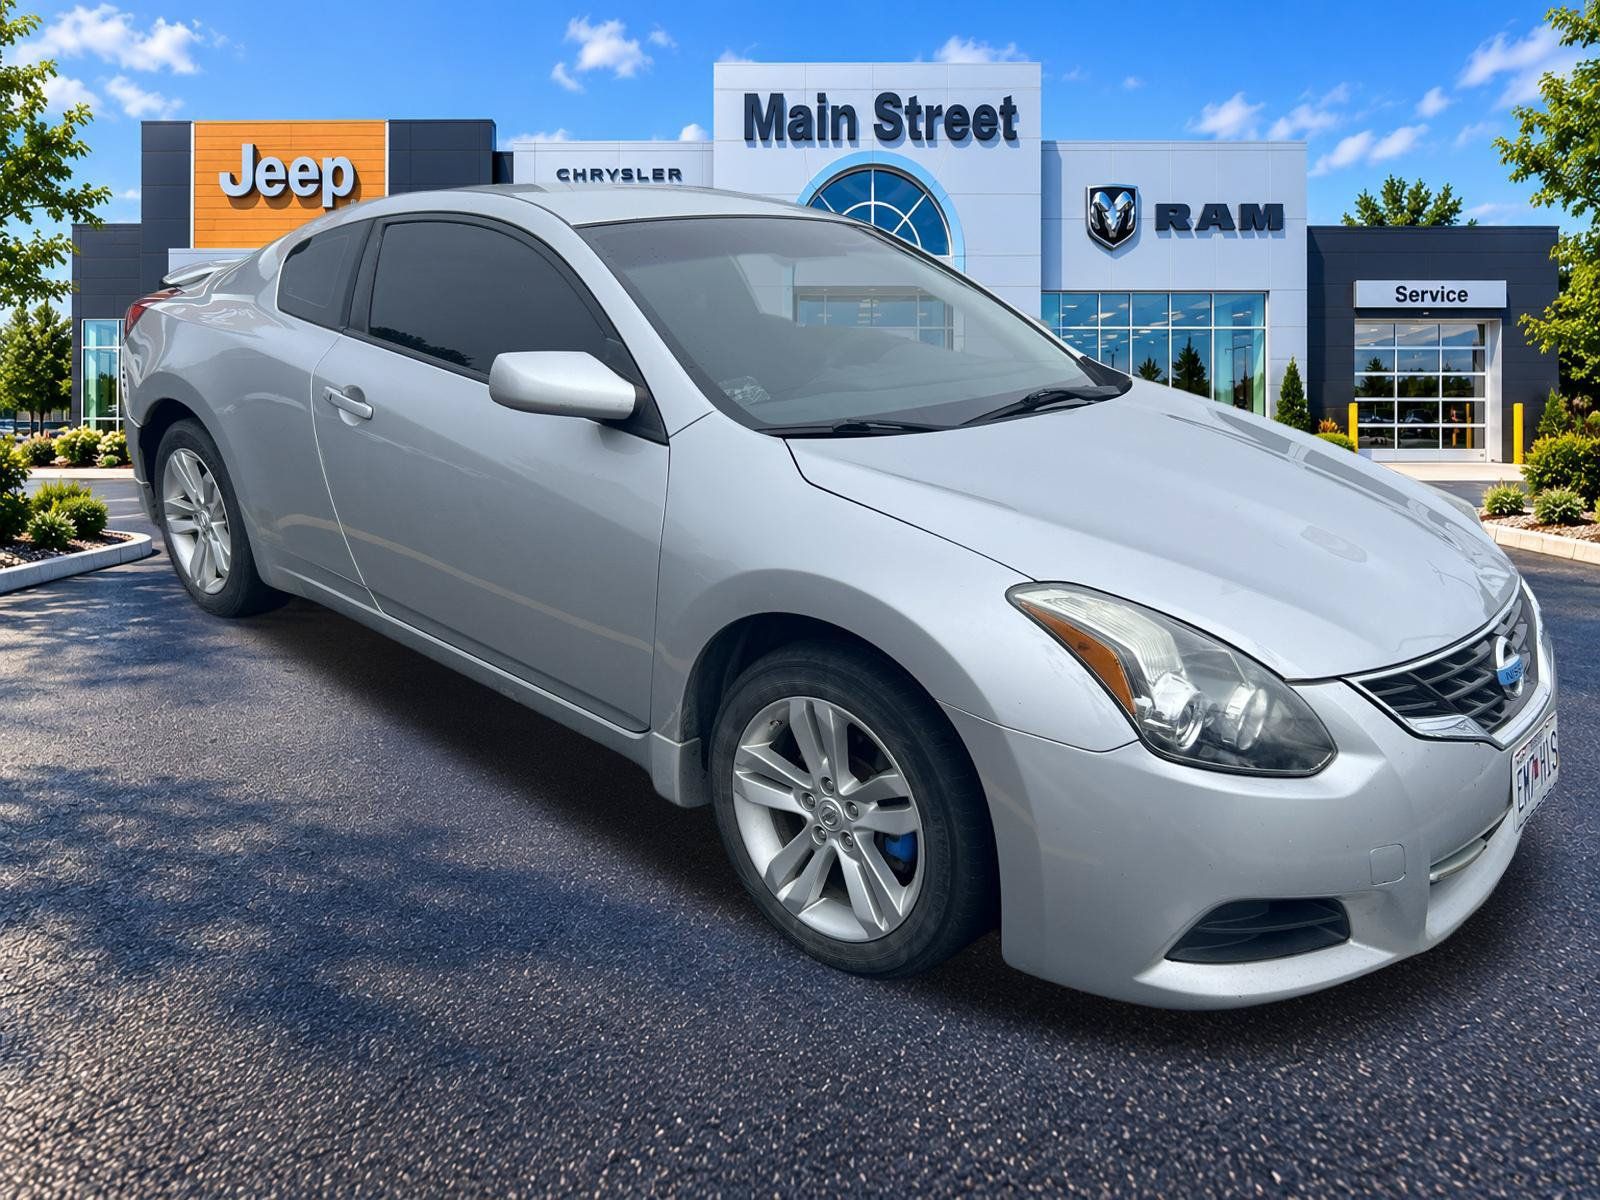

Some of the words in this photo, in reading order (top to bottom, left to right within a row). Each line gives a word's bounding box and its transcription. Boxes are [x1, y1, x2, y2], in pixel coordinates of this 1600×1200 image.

[743, 92, 857, 142] Main
[873, 91, 1018, 142] Street
[218, 143, 354, 209] Jeep
[556, 167, 683, 183] CHRYSLER
[1154, 203, 1284, 232] RAM
[1395, 285, 1469, 303] Service
